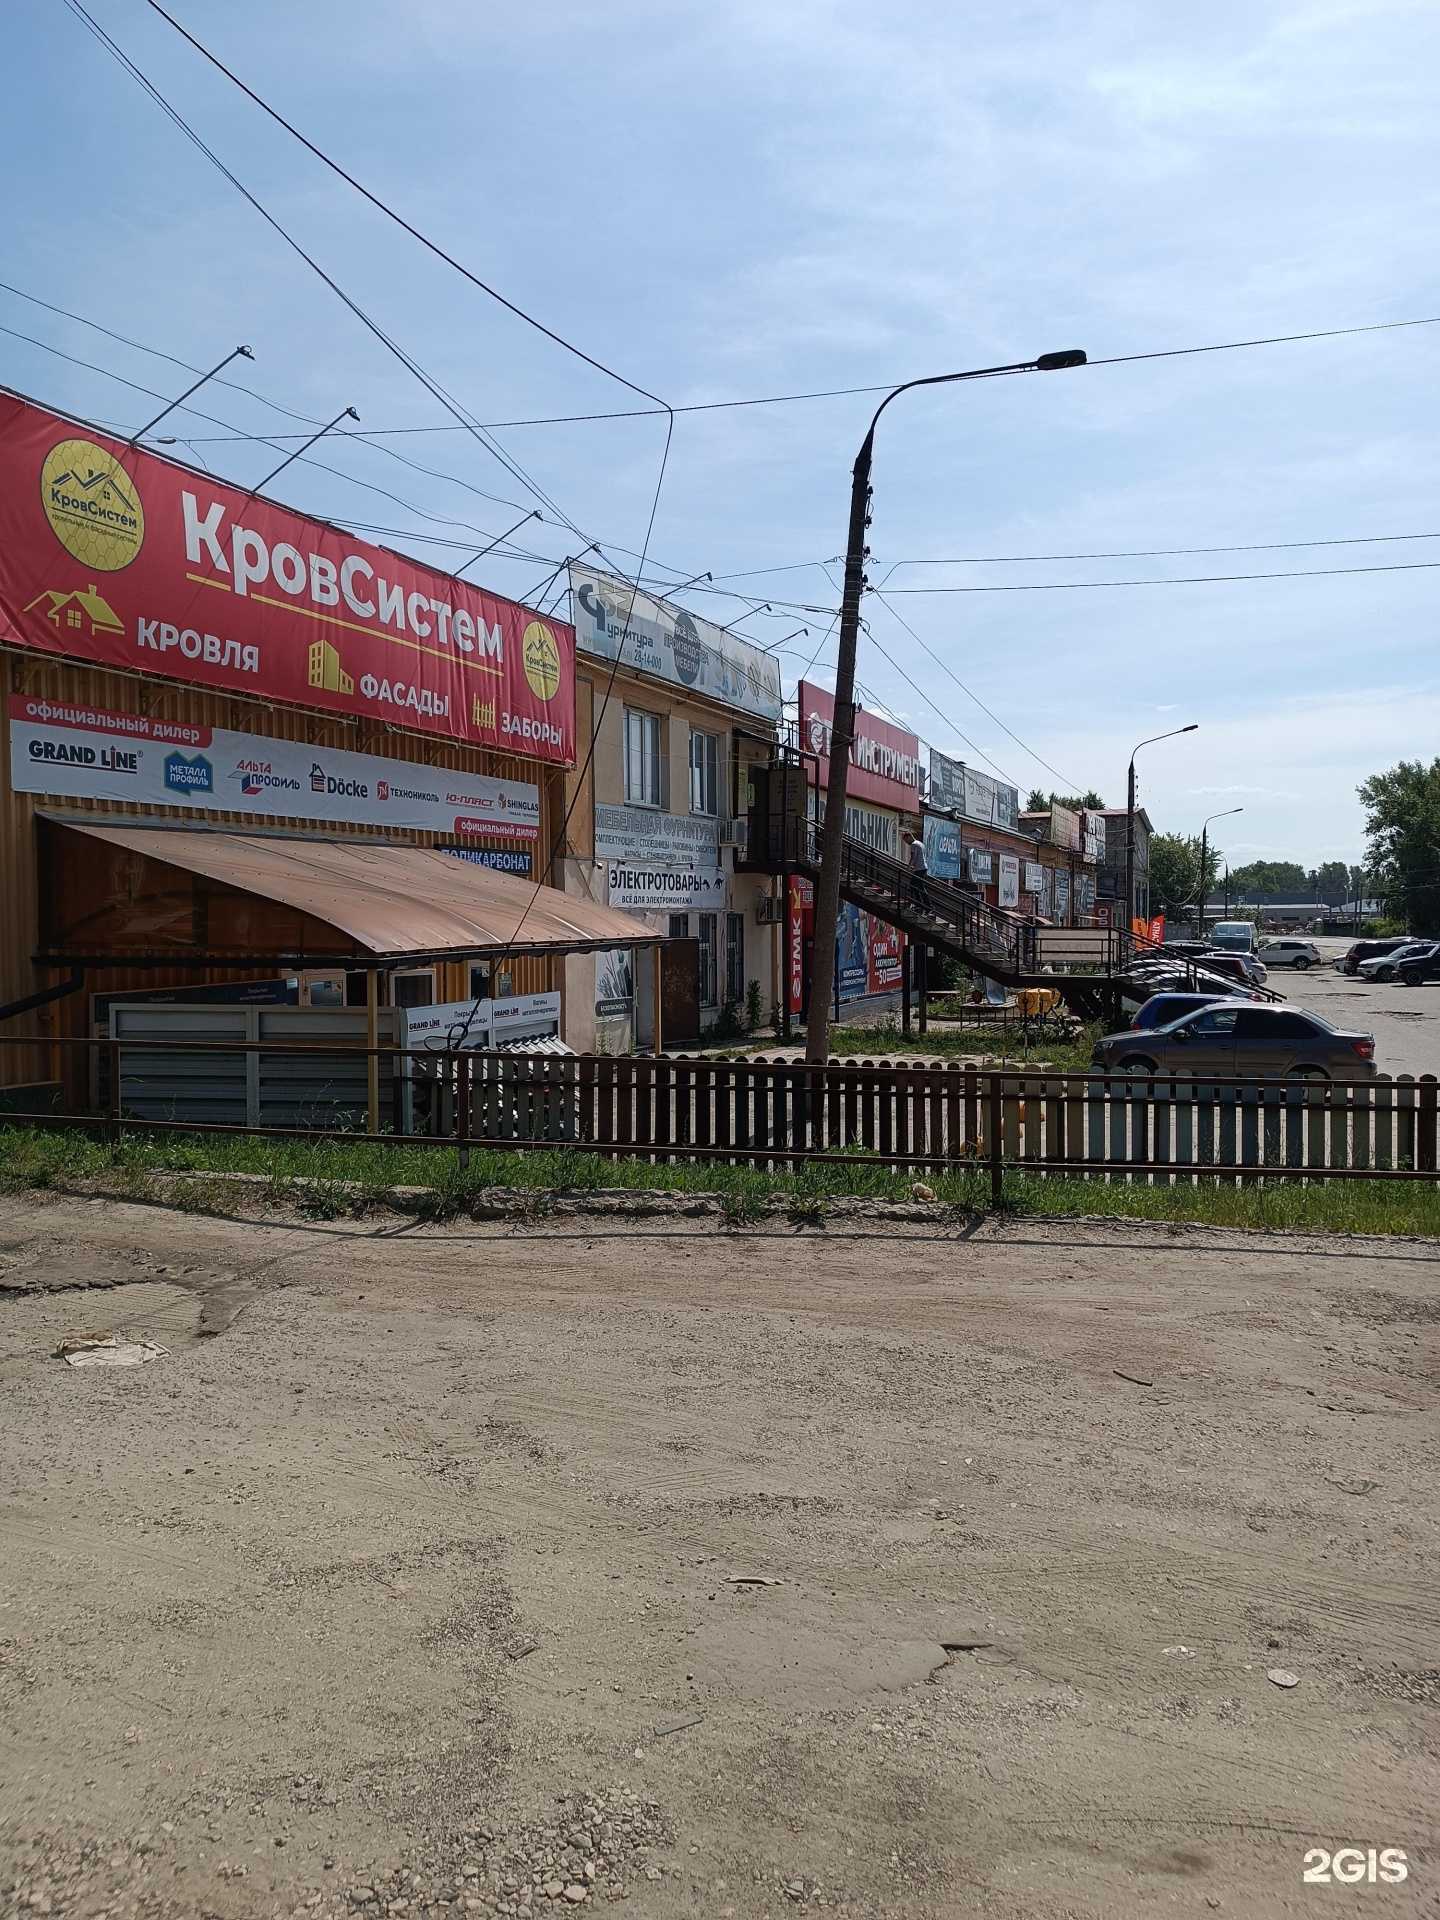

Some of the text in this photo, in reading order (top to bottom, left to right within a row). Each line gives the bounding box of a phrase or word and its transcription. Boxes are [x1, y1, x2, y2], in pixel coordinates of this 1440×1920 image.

[51, 487, 138, 529] КровСистем
[181, 490, 505, 664] КровСистем
[137, 616, 260, 673] КРОВЛЯ
[360, 673, 450, 718] ФАСАДЫ
[25, 701, 201, 745] официальный дилер
[501, 712, 564, 747] ЗАБОРЫ
[28, 739, 97, 765] GRAND
[857, 734, 920, 788] ИНСТРУМЕНТ
[169, 763, 208, 778] МЕТАЛЛ
[236, 758, 273, 776] АЛЬТА
[169, 773, 210, 787] ПРОФИЛЬ
[251, 773, 301, 791] ПРОФИЛЬ
[327, 775, 369, 799] Döcke
[390, 786, 440, 803] ТЕХНОНИКОЛЬ
[445, 792, 495, 808] Ю-ПЛАСТ
[507, 798, 540, 813] SHINGLAS
[461, 819, 539, 839] официальный дилер
[609, 868, 703, 892] ЭЛЕКТРОТОВАРЫ
[633, 895, 646, 905] ДЛЯ
